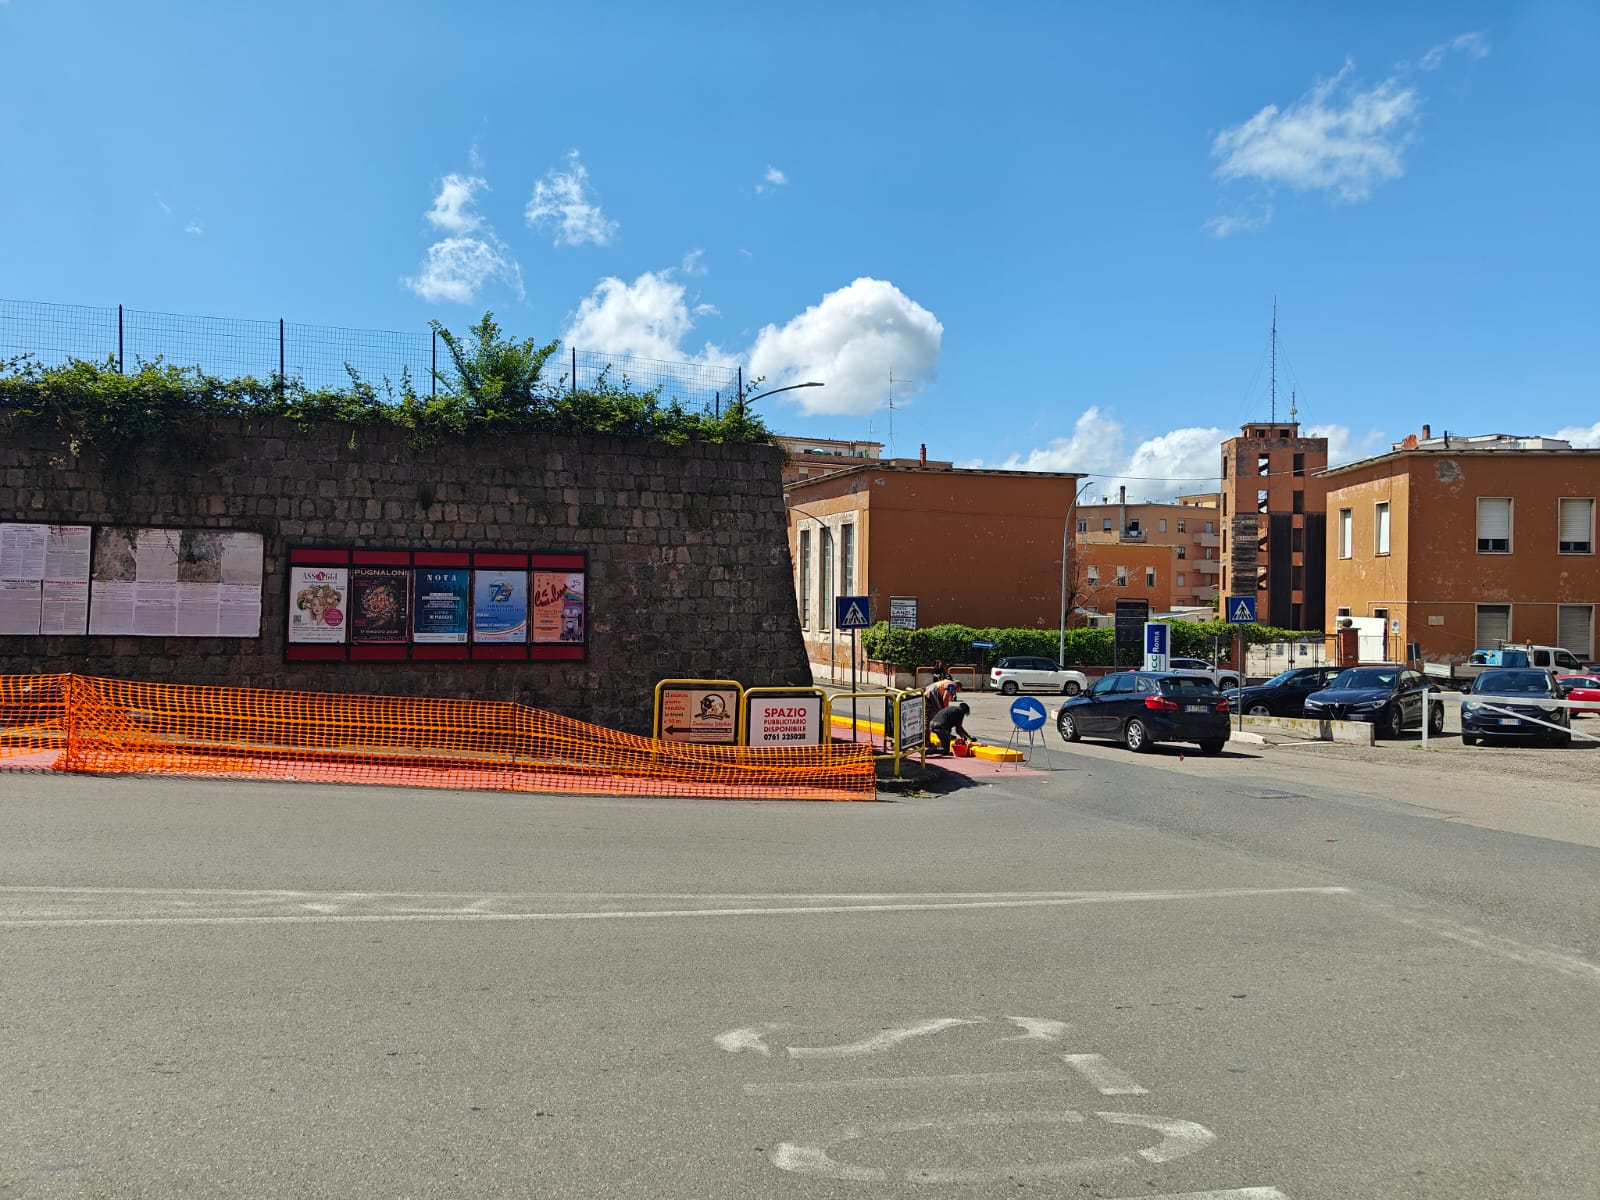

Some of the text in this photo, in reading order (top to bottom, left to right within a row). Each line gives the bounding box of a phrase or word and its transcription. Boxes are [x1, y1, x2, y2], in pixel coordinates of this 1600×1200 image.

[1152, 631, 1160, 653] Roma
[764, 707, 807, 718] SPAZIO
[763, 725, 807, 733] DISPONIBILE
[763, 733, 806, 741] 0761 325028
